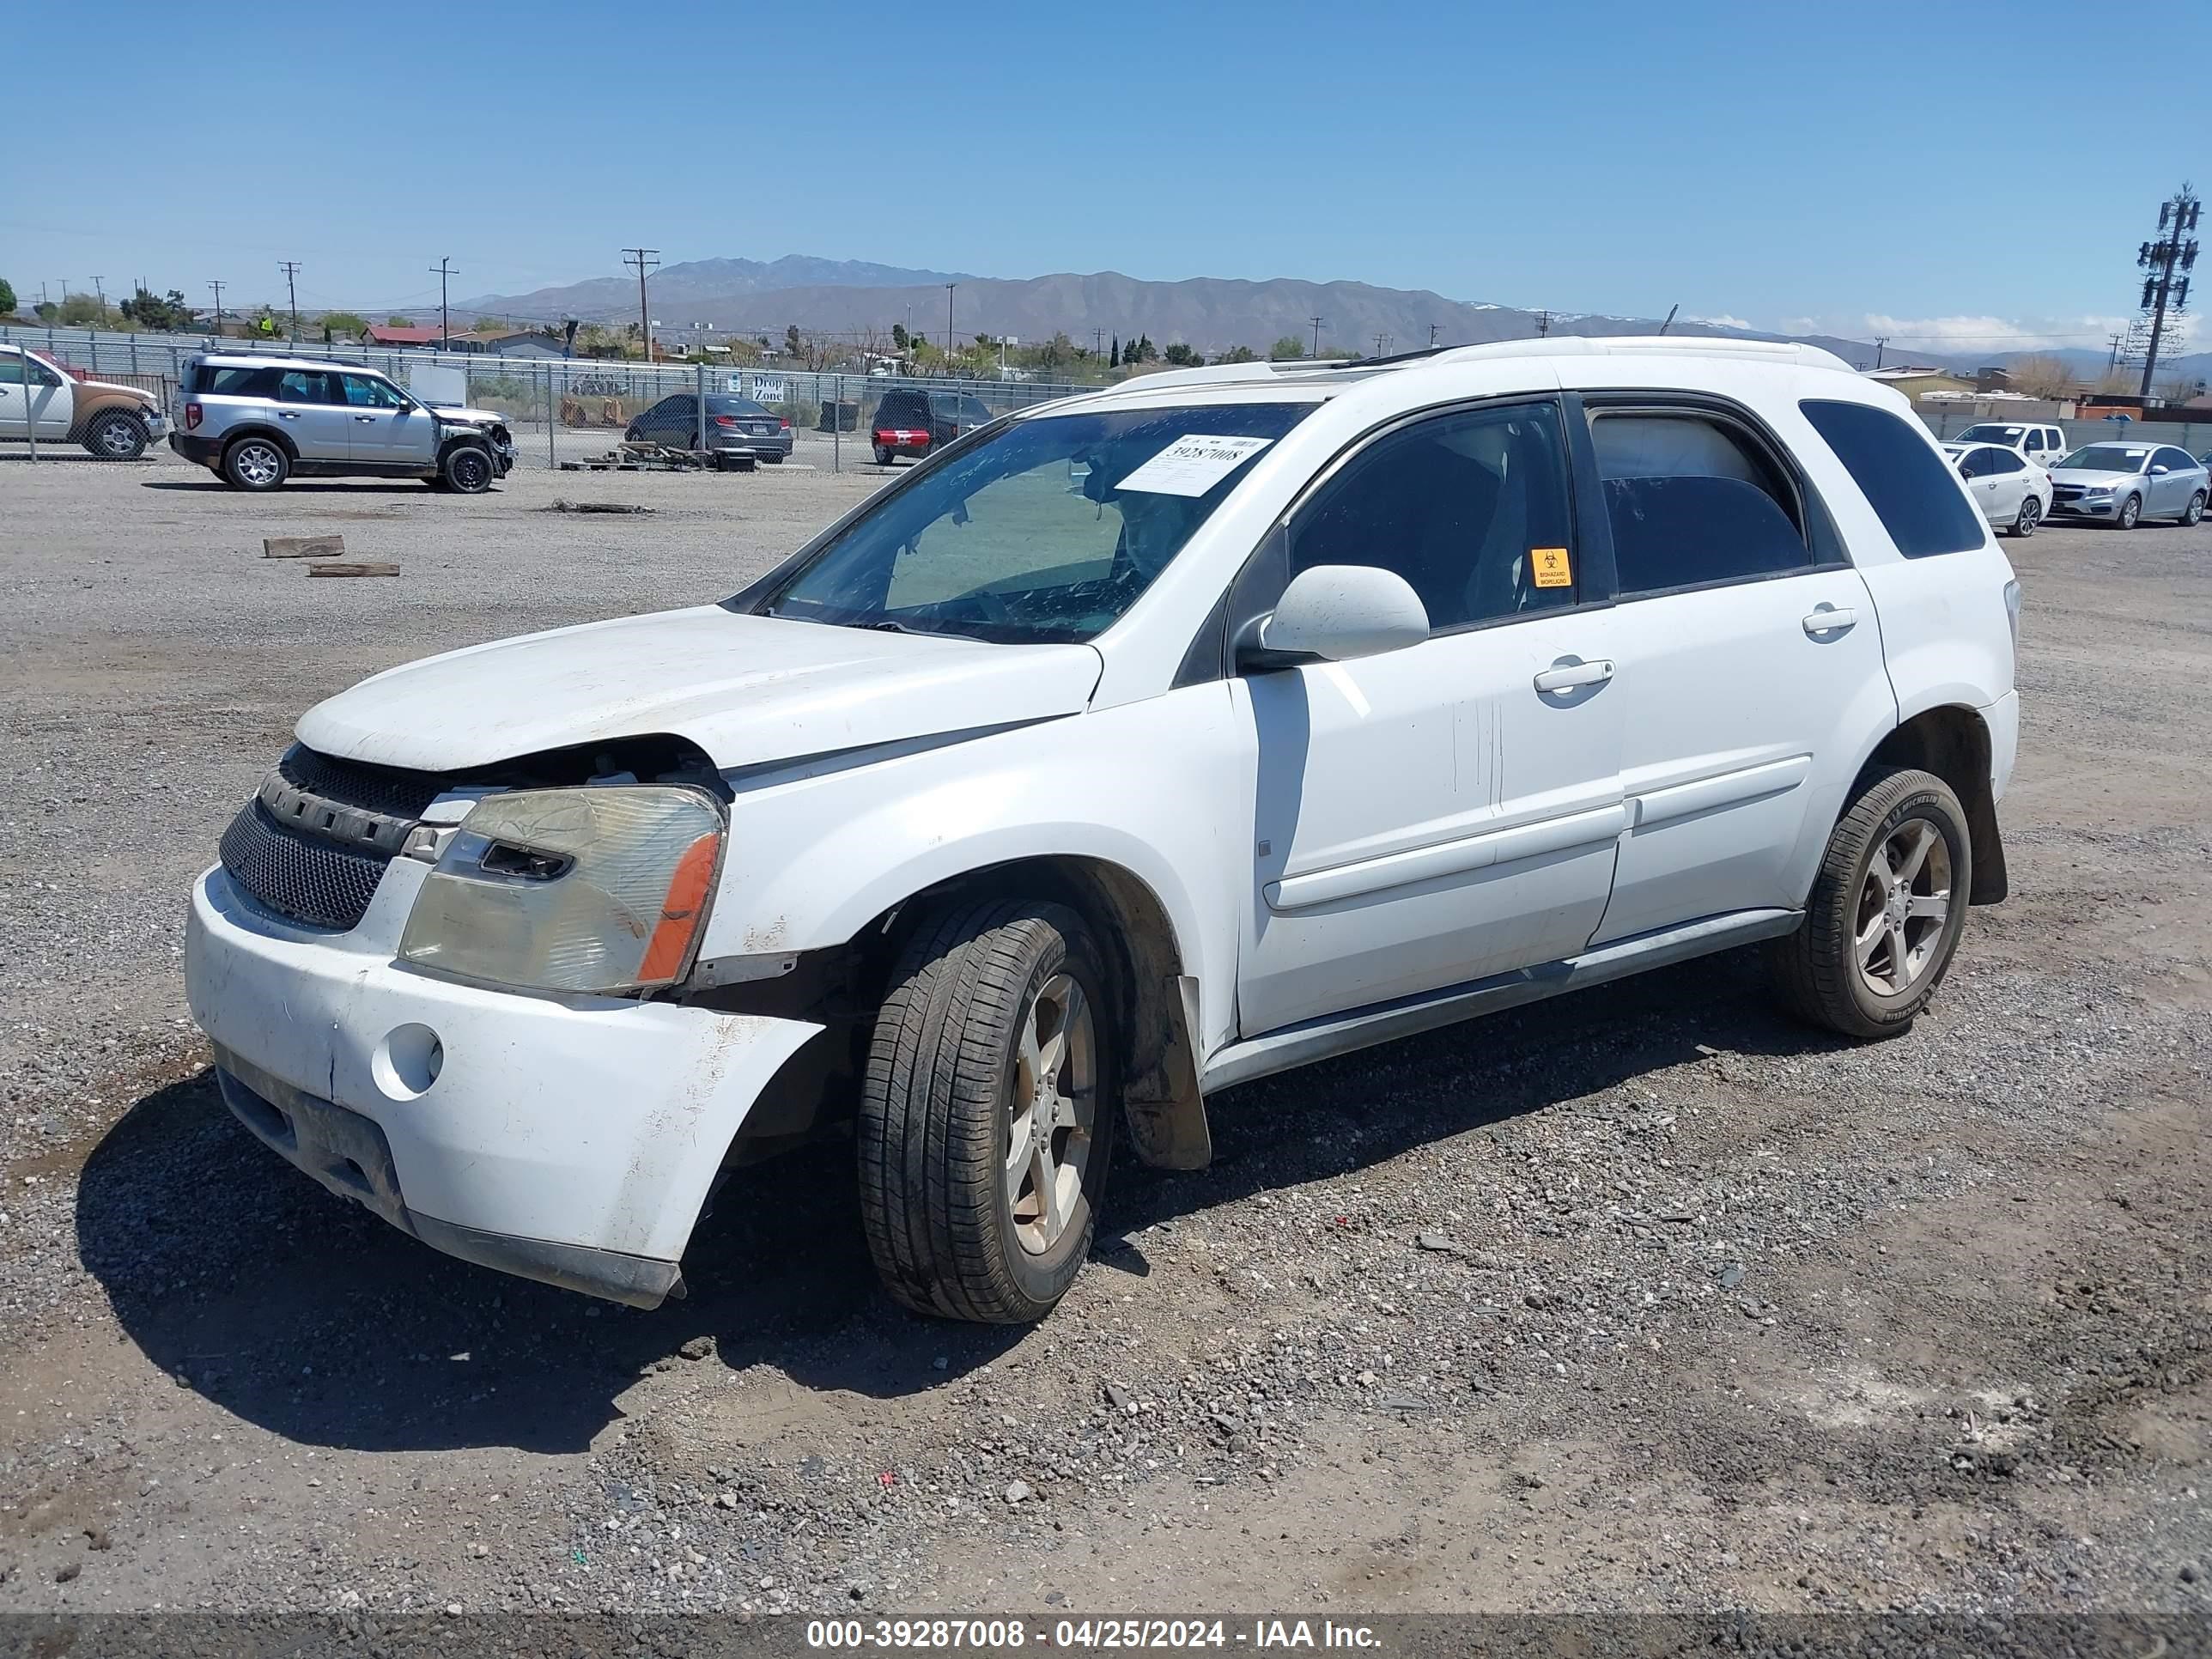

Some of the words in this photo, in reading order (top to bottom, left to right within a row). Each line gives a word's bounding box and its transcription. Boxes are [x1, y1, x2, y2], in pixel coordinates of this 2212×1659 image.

[755, 376, 782, 390] Drop
[755, 389, 782, 401] Zone
[1166, 446, 1244, 461] 39287008
[1902, 795, 1938, 812] MICHELIN
